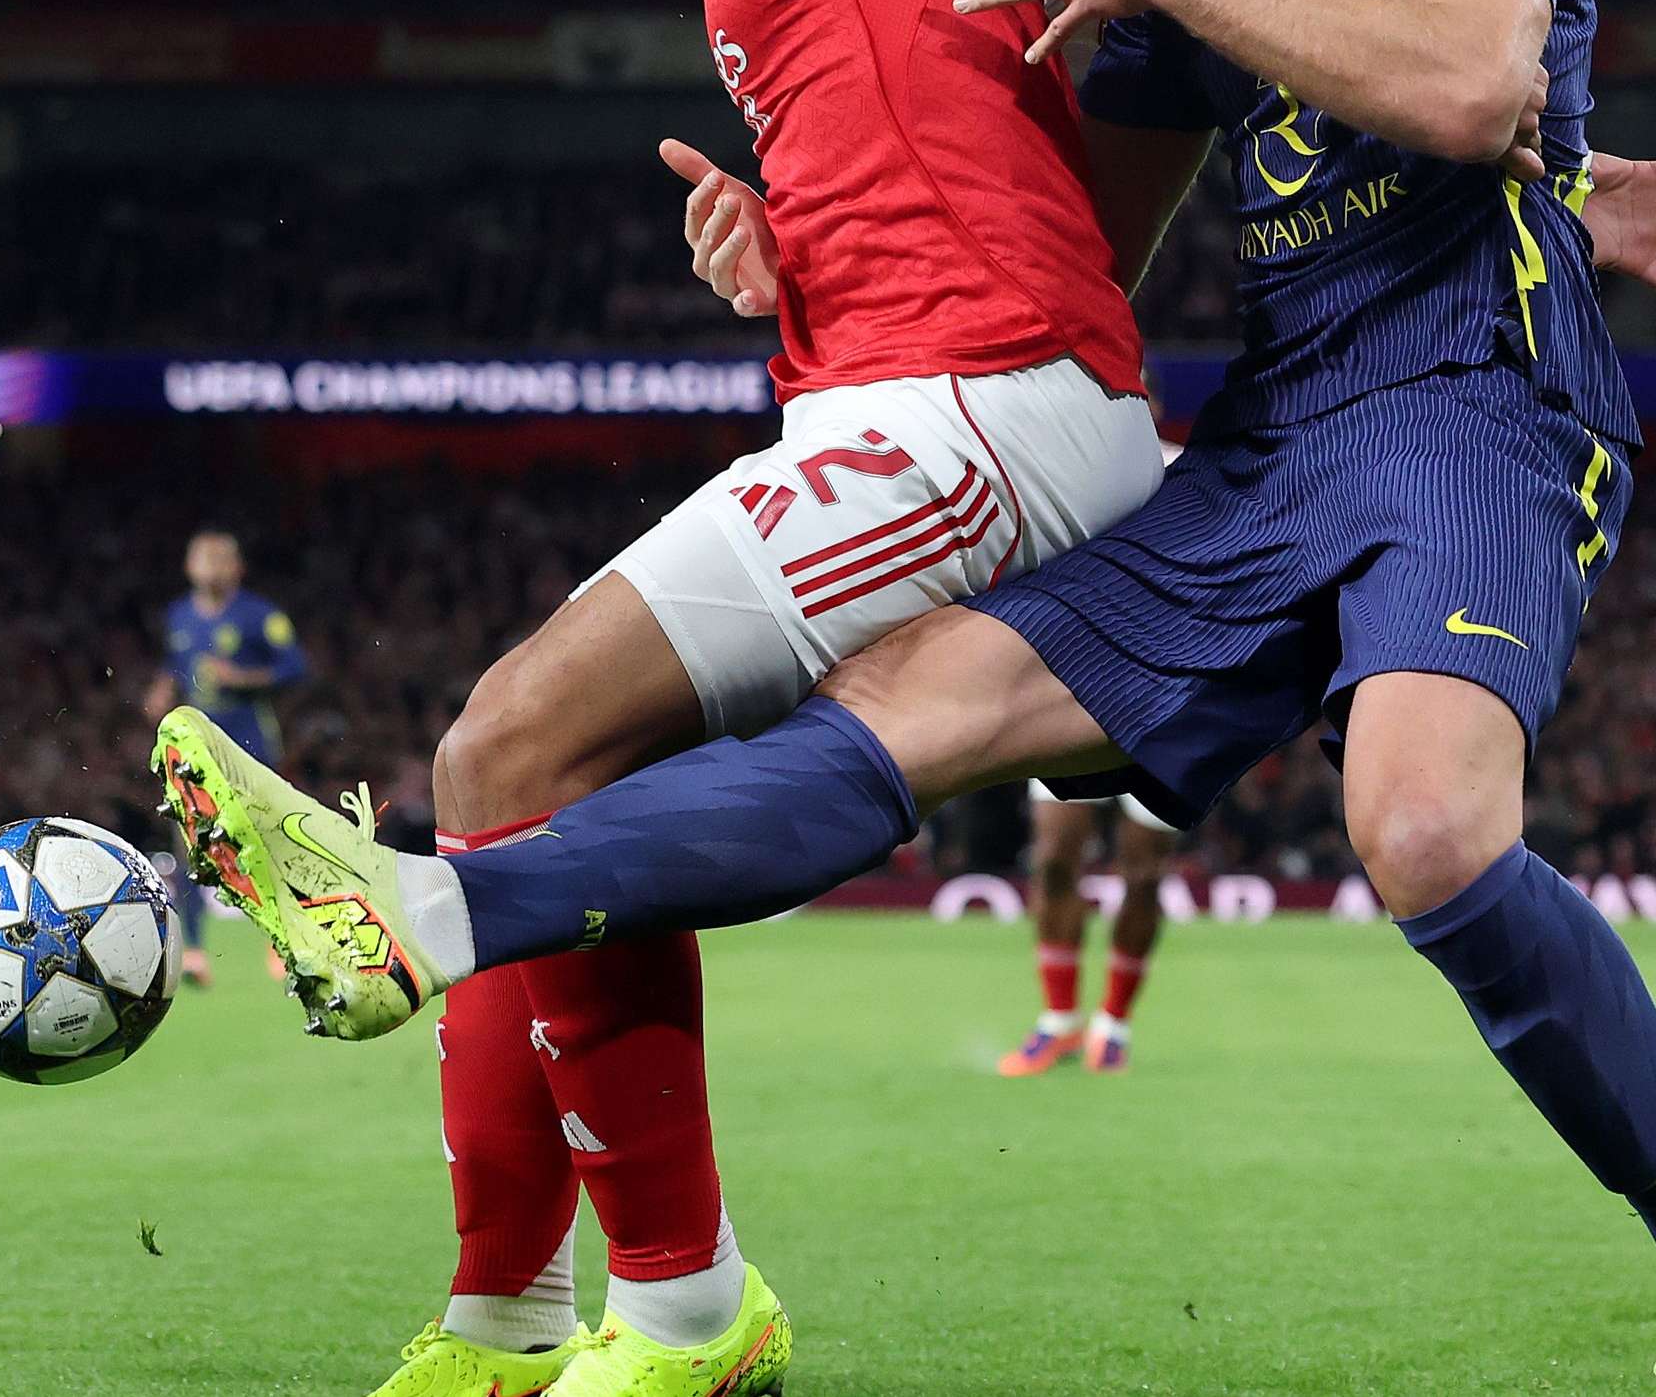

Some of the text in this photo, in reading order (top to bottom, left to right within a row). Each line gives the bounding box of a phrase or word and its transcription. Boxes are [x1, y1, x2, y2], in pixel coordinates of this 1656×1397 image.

[1241, 172, 1409, 260] RIYADH AIR
[163, 360, 768, 413] UEFA CHAMPIONS LEAGUE
[795, 428, 917, 507] 2
